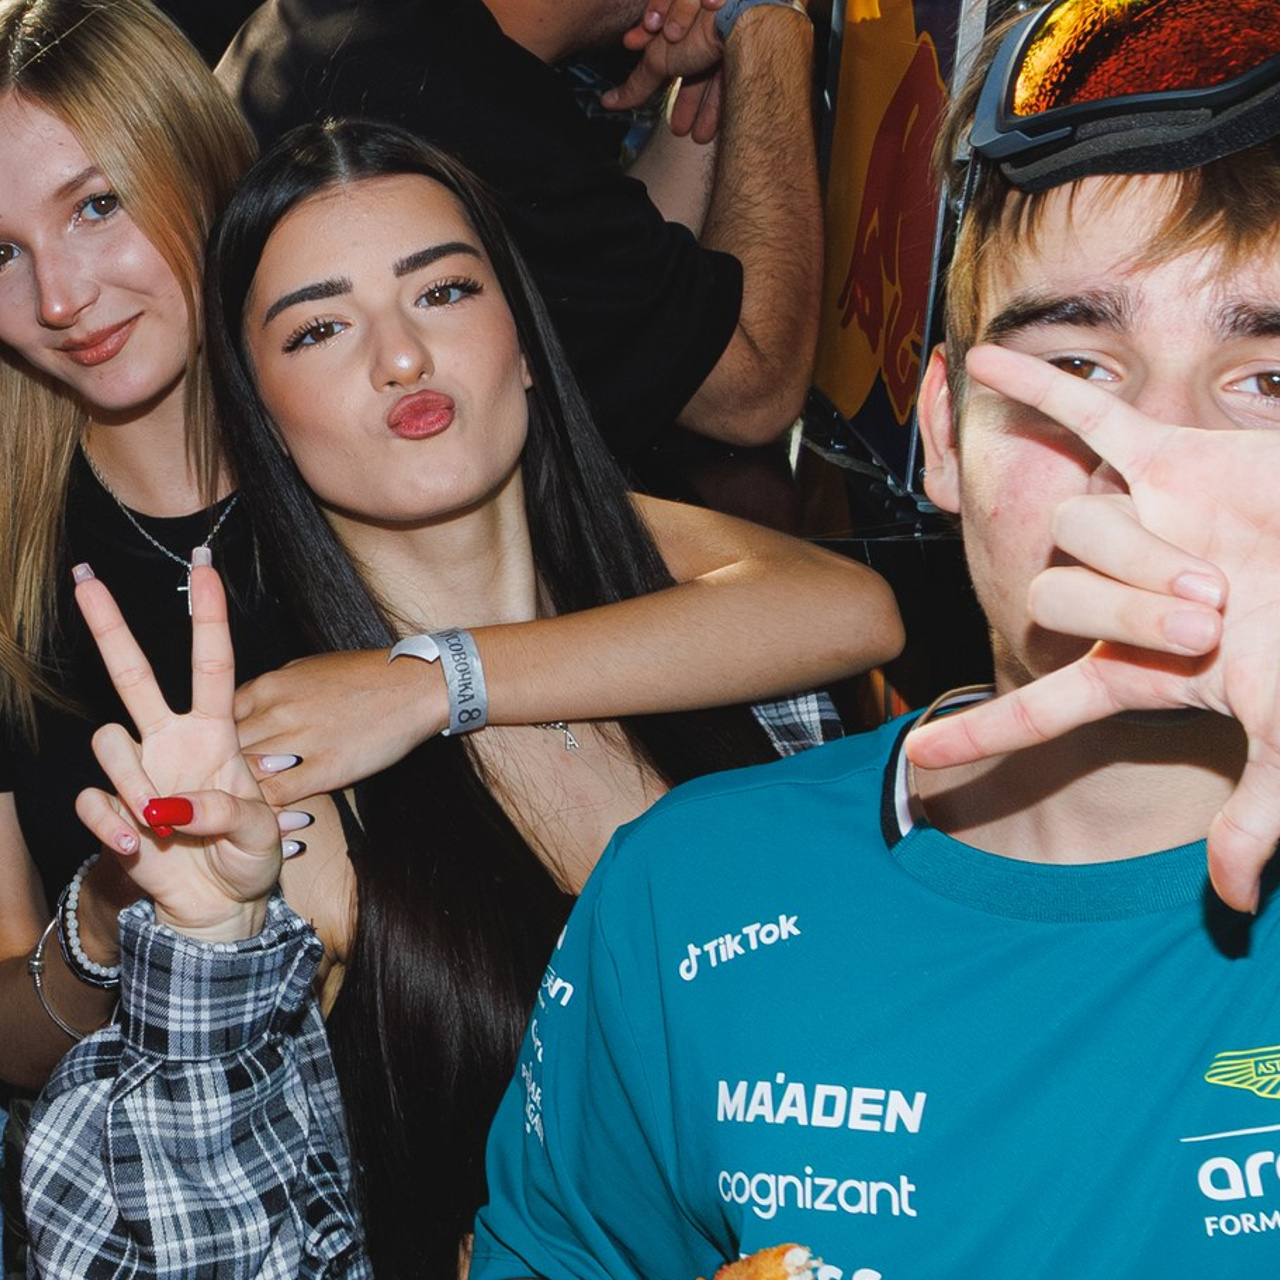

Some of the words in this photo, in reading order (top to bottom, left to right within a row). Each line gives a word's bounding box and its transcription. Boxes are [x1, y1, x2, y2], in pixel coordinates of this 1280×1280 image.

[458, 707, 482, 725] 8
[703, 913, 802, 968] TikTok
[718, 1165, 918, 1221] cognizant
[1198, 1150, 1280, 1202] ar
